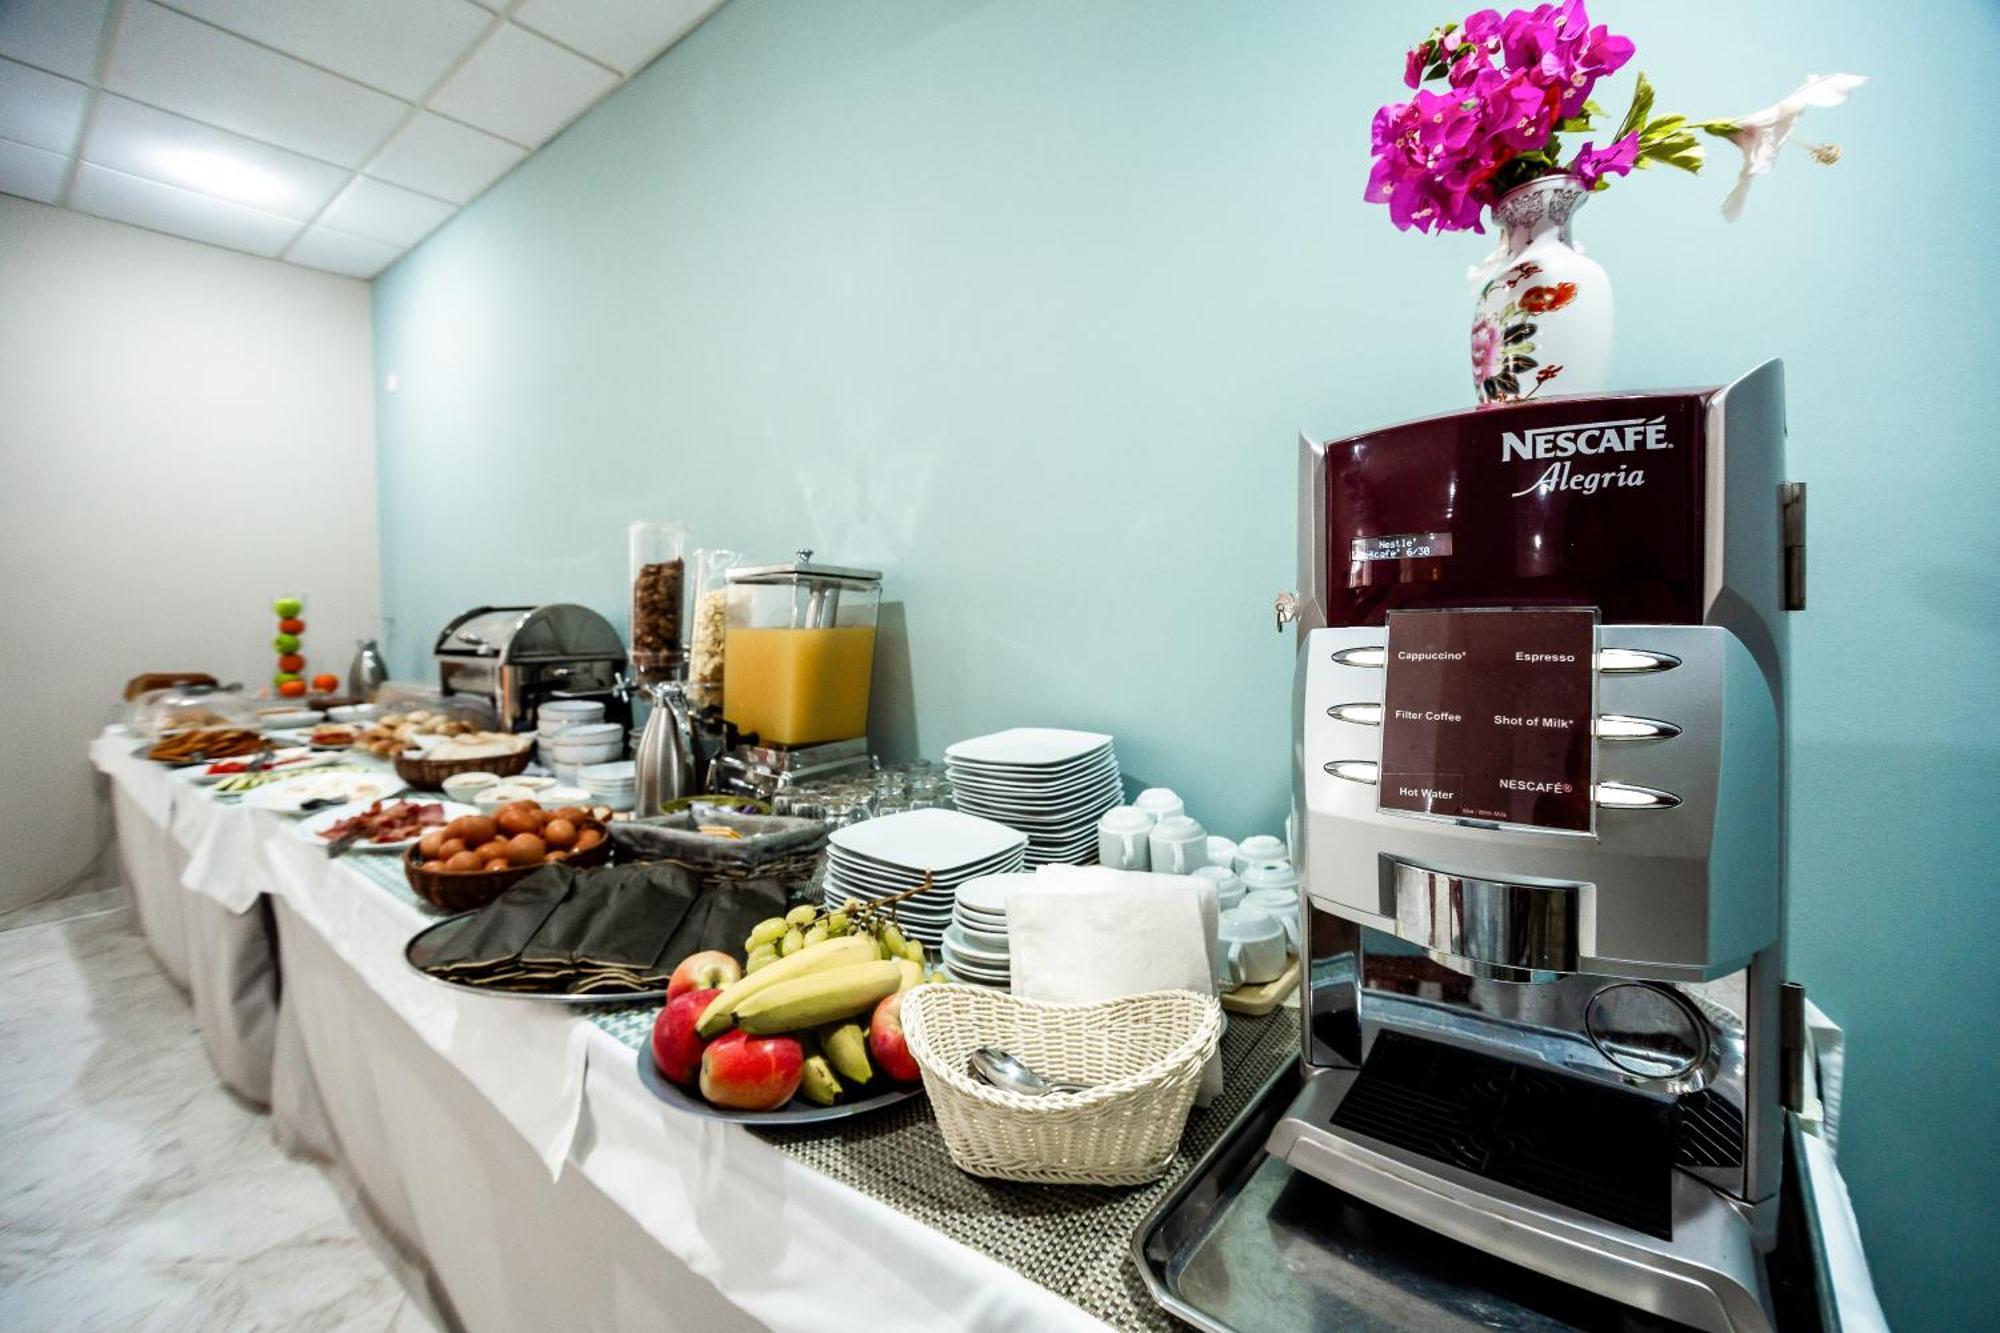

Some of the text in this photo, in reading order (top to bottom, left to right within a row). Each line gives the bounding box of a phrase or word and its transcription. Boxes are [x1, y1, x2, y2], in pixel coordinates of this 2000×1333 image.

[1512, 461, 1645, 497] Alegria
[1515, 651, 1575, 663] Espresso
[1395, 710, 1462, 722] Filter Coffee
[1494, 715, 1522, 726] Shot
[1526, 716, 1539, 727] of
[1400, 787, 1454, 800] Hot Water
